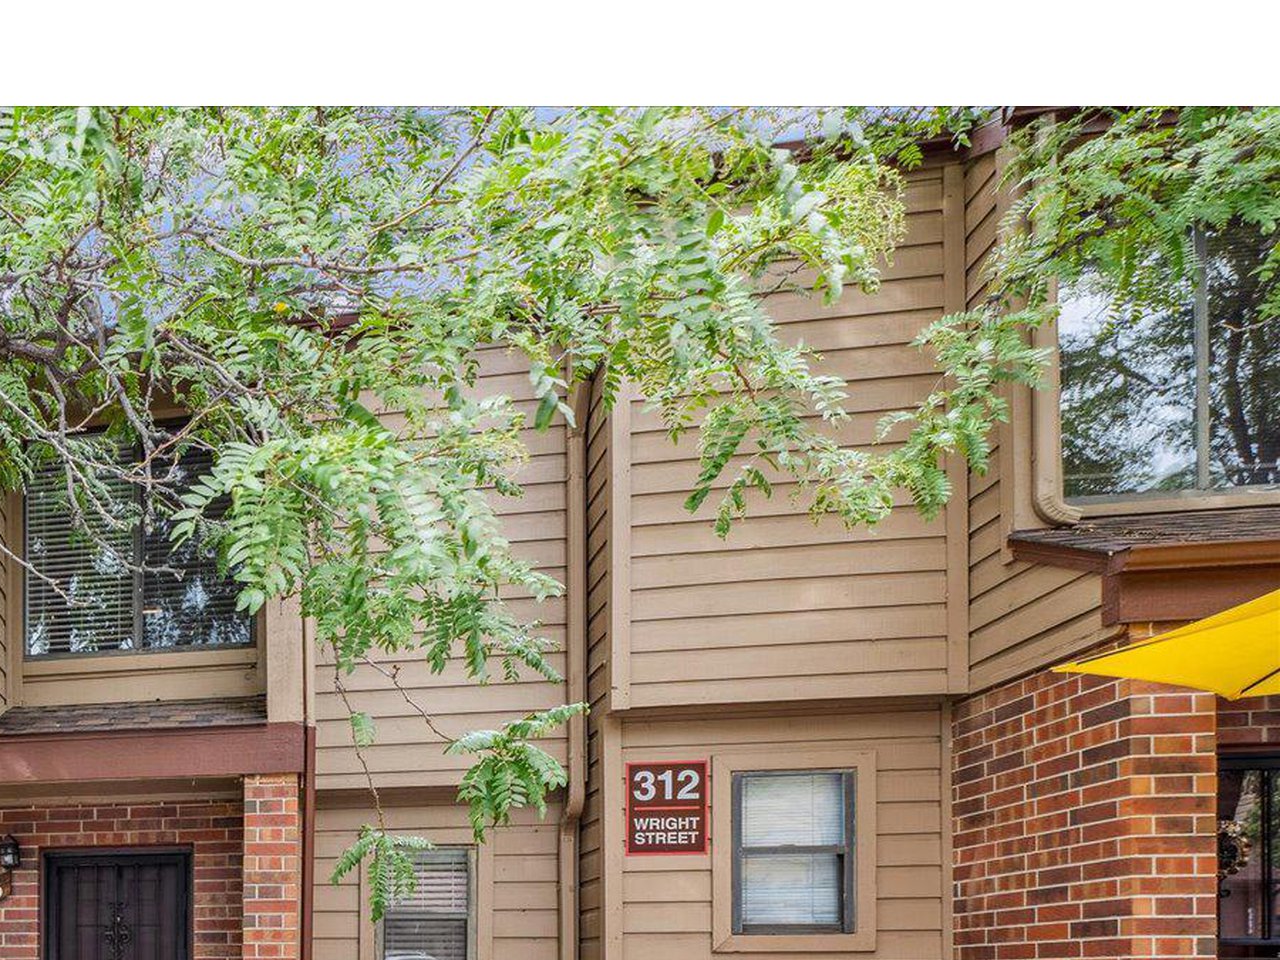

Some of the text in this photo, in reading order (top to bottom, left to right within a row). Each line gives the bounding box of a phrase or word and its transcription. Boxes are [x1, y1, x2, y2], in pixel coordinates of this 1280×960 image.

[633, 769, 700, 801] 312
[634, 817, 700, 830] WRIGHT
[634, 832, 699, 845] STREET
